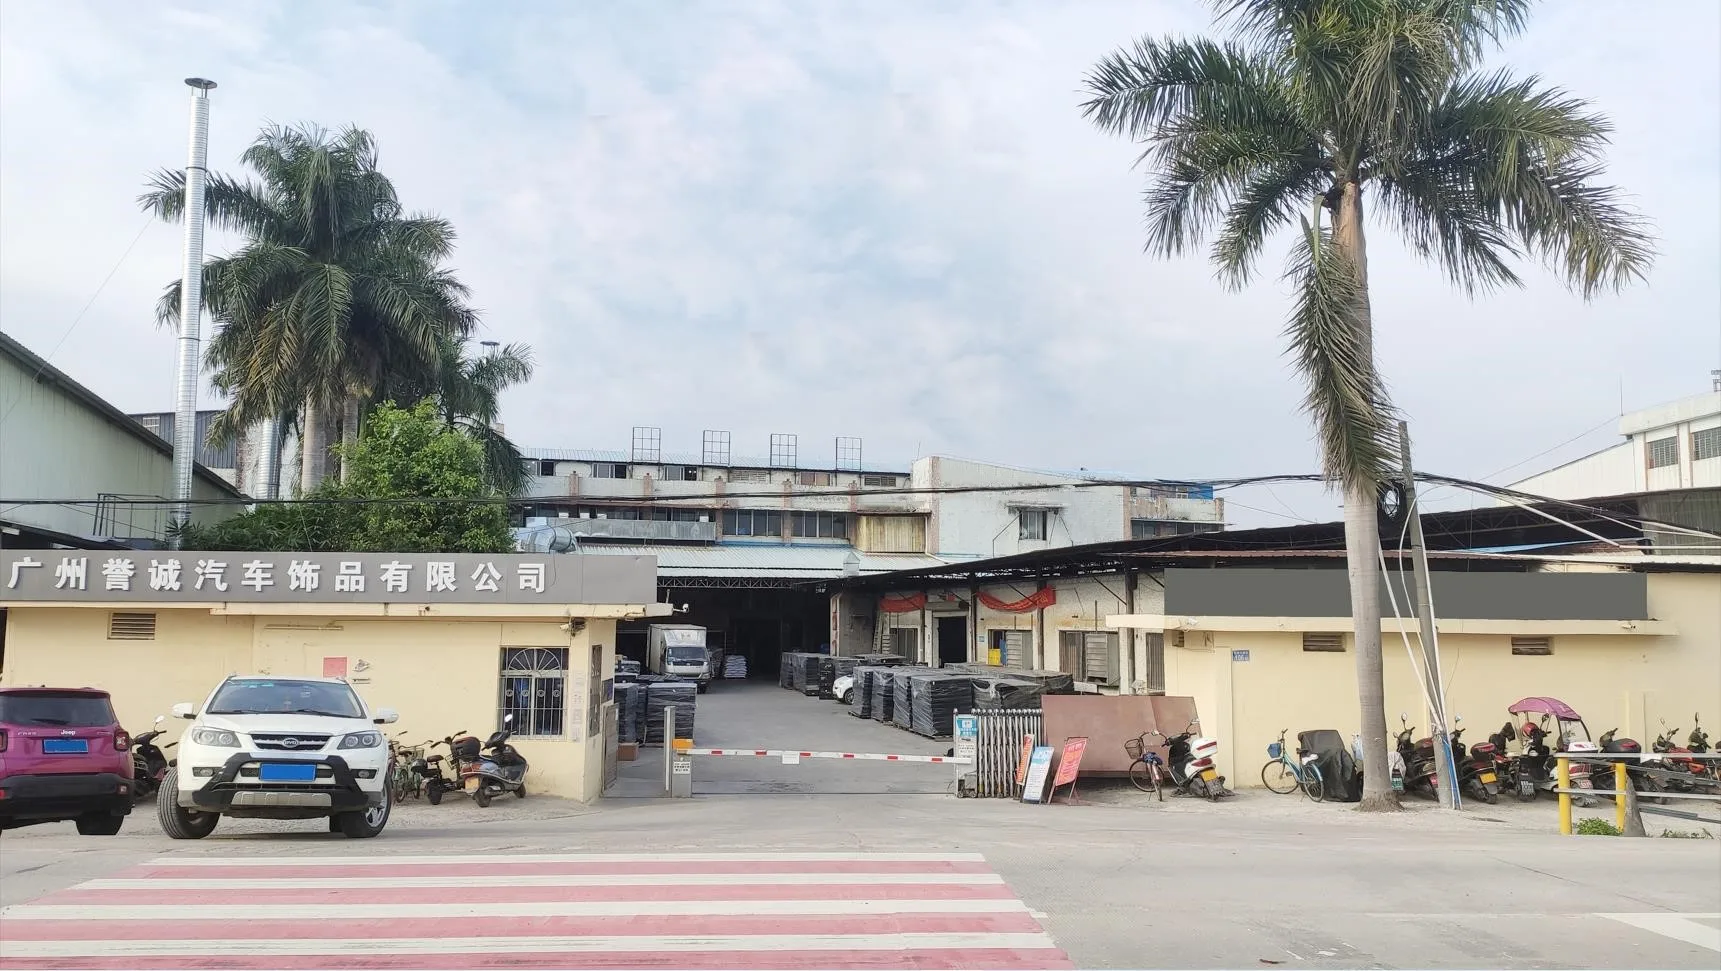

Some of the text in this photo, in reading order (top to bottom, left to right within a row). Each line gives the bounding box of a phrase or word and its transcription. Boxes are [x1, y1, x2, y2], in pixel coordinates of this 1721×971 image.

[8, 556, 545, 593] 广州誉诚汽车饰品有限公司
